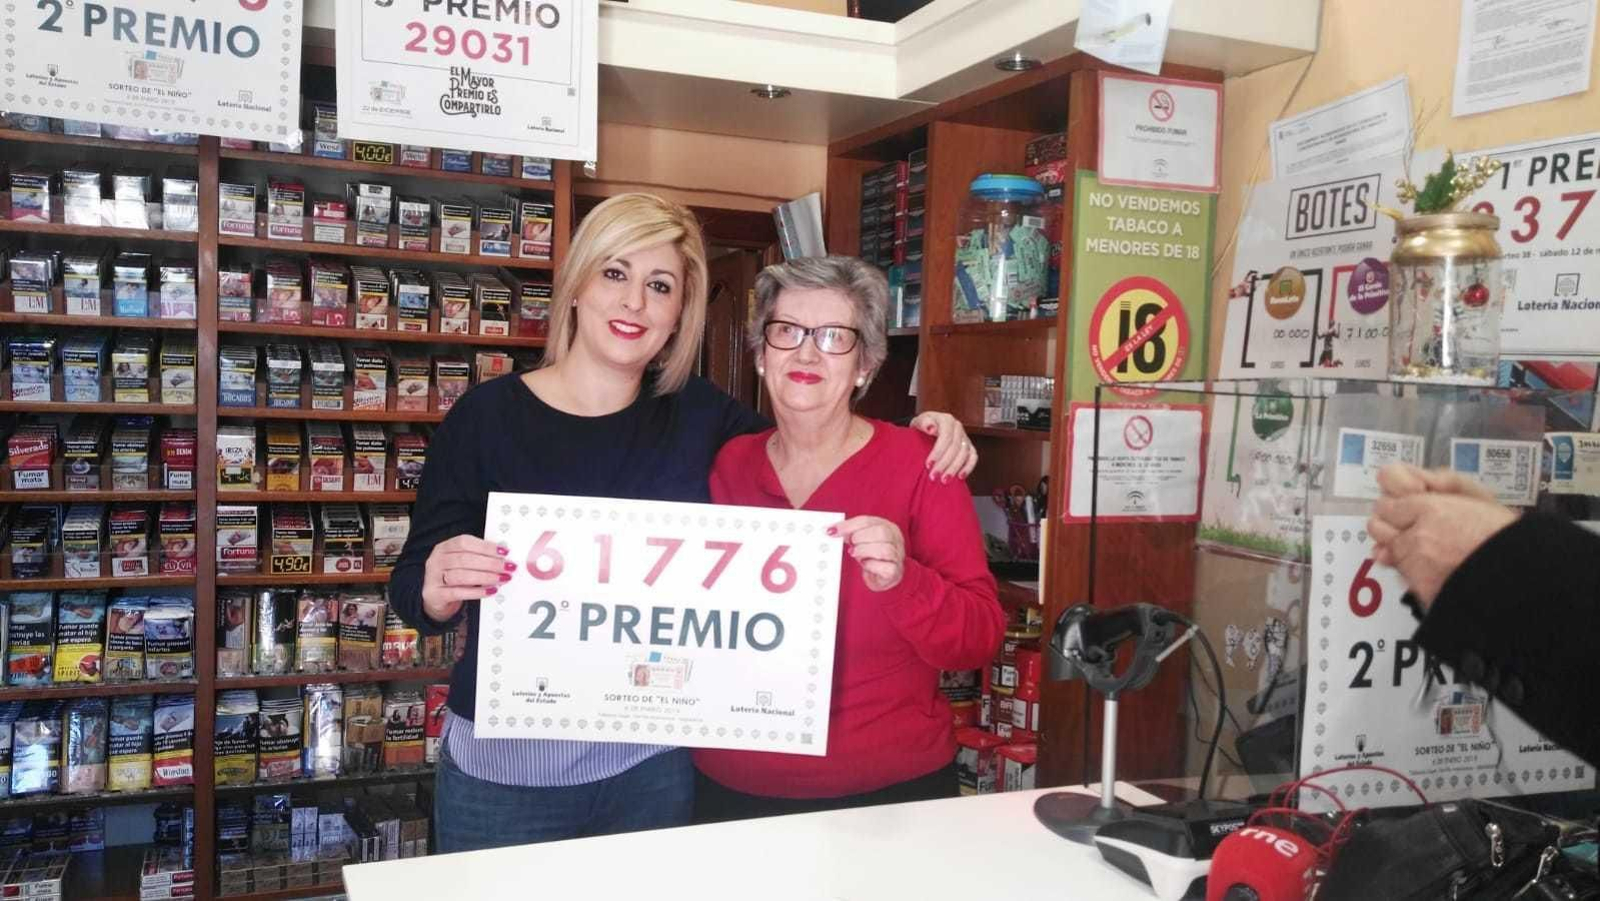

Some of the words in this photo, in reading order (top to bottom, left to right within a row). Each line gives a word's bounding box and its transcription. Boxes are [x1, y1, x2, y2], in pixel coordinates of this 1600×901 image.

[423, 0, 560, 28] PREMIO
[83, 3, 260, 58] PREMIO
[404, 21, 530, 66] 29031
[450, 66, 460, 76] EL
[108, 82, 139, 94] SORTEO
[440, 94, 501, 118] COMPARTIRLO
[1528, 148, 1600, 187] PRE
[1089, 192, 1114, 208] NO
[1116, 194, 1201, 215] VENDEMOS
[1295, 182, 1370, 233] BOTES
[1106, 216, 1168, 234] TABACO
[1172, 222, 1183, 236] A
[1085, 237, 1160, 257] MENORES
[1163, 244, 1183, 258] DE
[1186, 245, 1200, 260] 18
[1561, 298, 1600, 310] Nacion
[1116, 301, 1167, 374] 18
[526, 529, 798, 594] 61776
[528, 600, 570, 640] 2º
[578, 602, 785, 652] PREMIO
[1348, 638, 1386, 689] 2º
[604, 693, 640, 703] SORTEO
[761, 708, 796, 717] Nacional
[1415, 746, 1444, 756] SORTEO
[1240, 828, 1299, 858] rne
